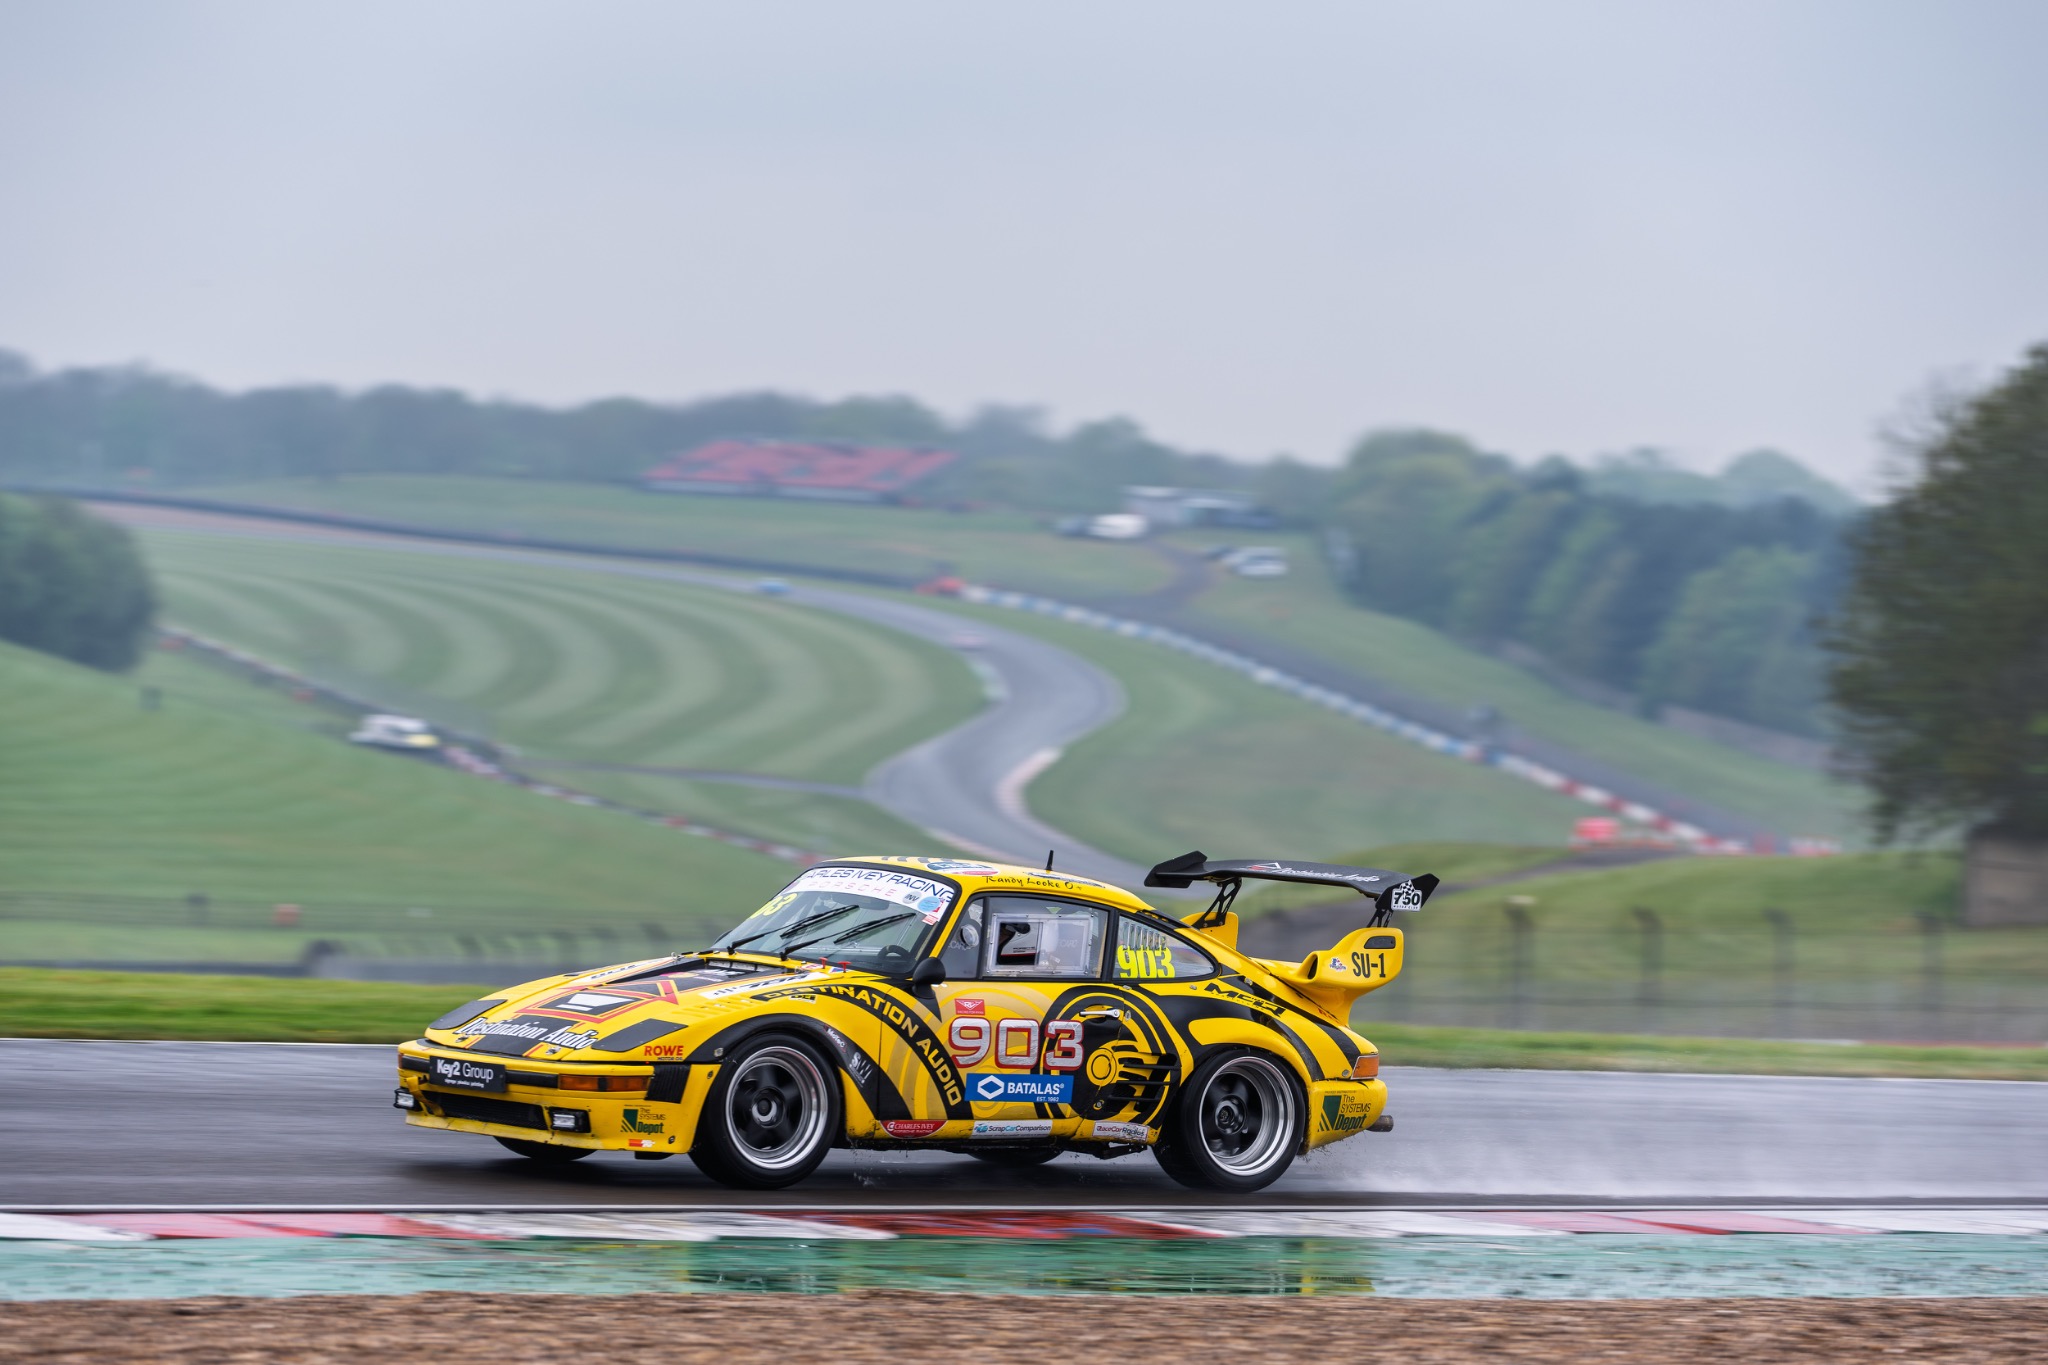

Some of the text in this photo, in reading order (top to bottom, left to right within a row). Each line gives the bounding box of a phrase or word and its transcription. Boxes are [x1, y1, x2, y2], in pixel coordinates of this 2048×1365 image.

[852, 870, 891, 881] IVEY
[887, 874, 954, 903] RACING
[1394, 890, 1421, 906] 750
[1117, 945, 1175, 978] 903
[1351, 951, 1386, 978] SU-1
[644, 1045, 684, 1056] ROWE
[764, 984, 962, 1106] DESTINATION AUDIO
[948, 1016, 1084, 1071] 903
[436, 1060, 494, 1083] Key2 Group
[1340, 1103, 1371, 1113] SYSTEMS
[1343, 1095, 1356, 1103] The
[637, 1121, 664, 1135] Depot
[1334, 1113, 1367, 1132] Depot
